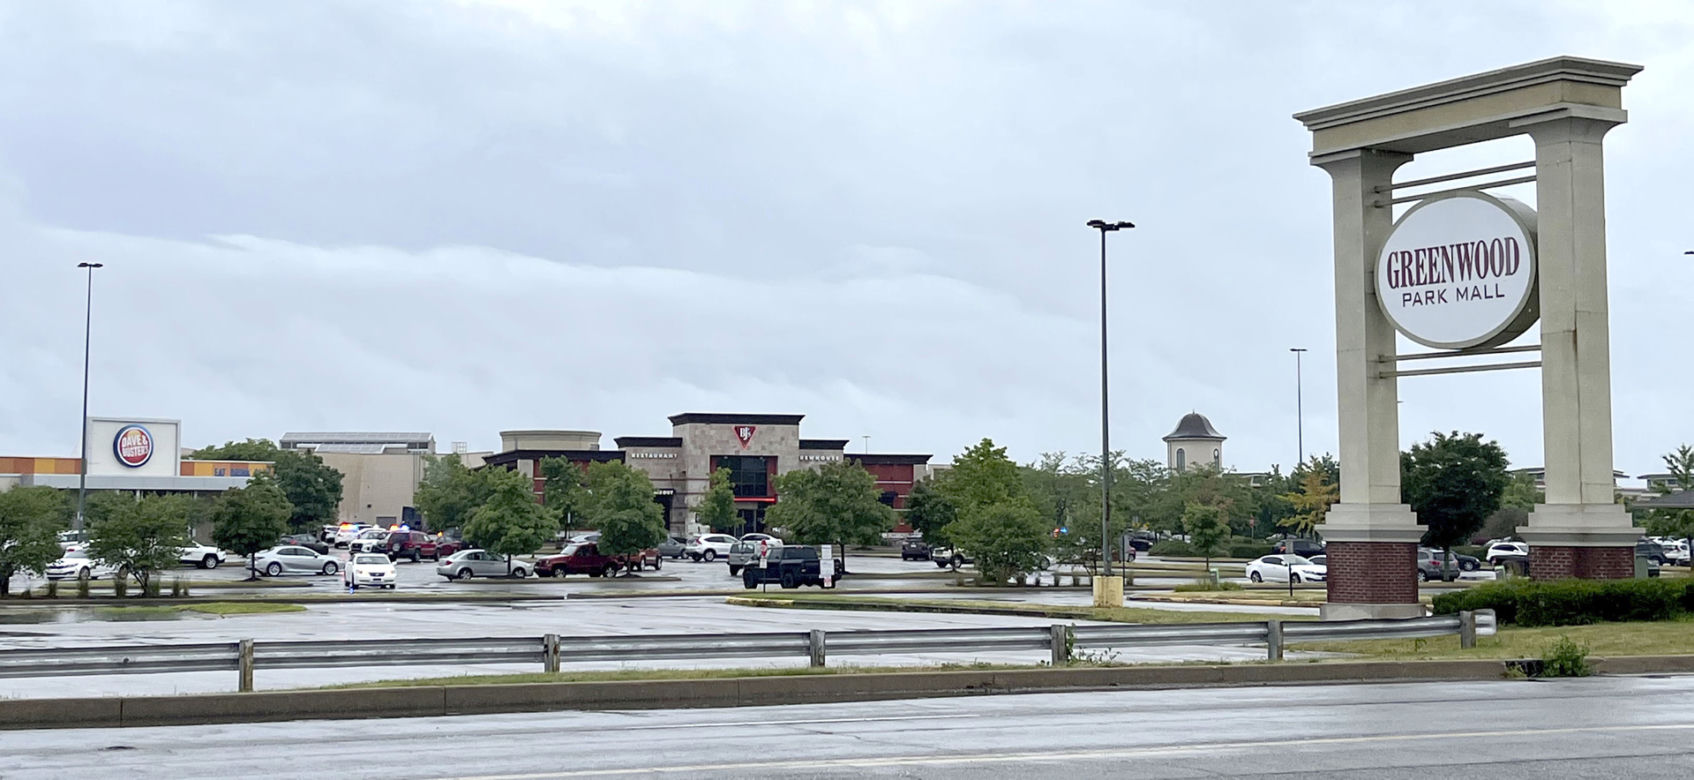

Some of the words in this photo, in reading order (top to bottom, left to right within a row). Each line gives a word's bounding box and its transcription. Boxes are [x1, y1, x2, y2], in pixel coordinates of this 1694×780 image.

[1386, 236, 1520, 289] GREENWOOD
[1402, 288, 1448, 307] PARK
[1456, 283, 1505, 302] MALL
[122, 435, 142, 447] DAVE
[142, 434, 148, 445] &
